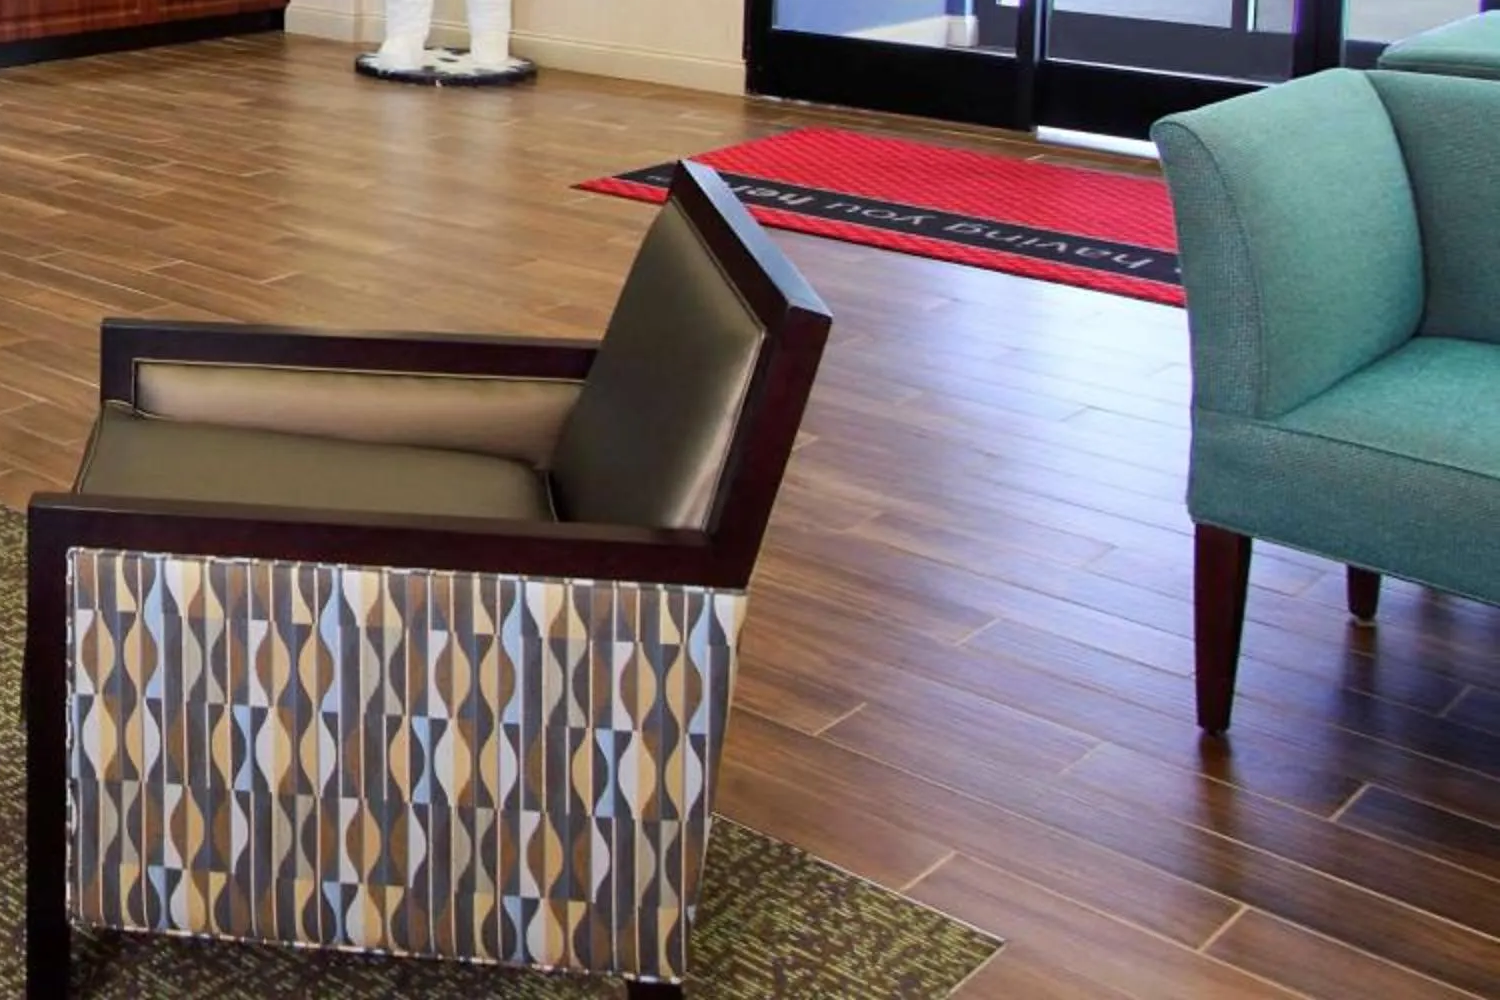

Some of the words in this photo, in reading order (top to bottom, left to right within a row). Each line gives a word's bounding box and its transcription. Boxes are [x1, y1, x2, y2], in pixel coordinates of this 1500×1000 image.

[732, 185, 816, 206] her
[824, 202, 937, 226] you
[942, 221, 1155, 269] having
